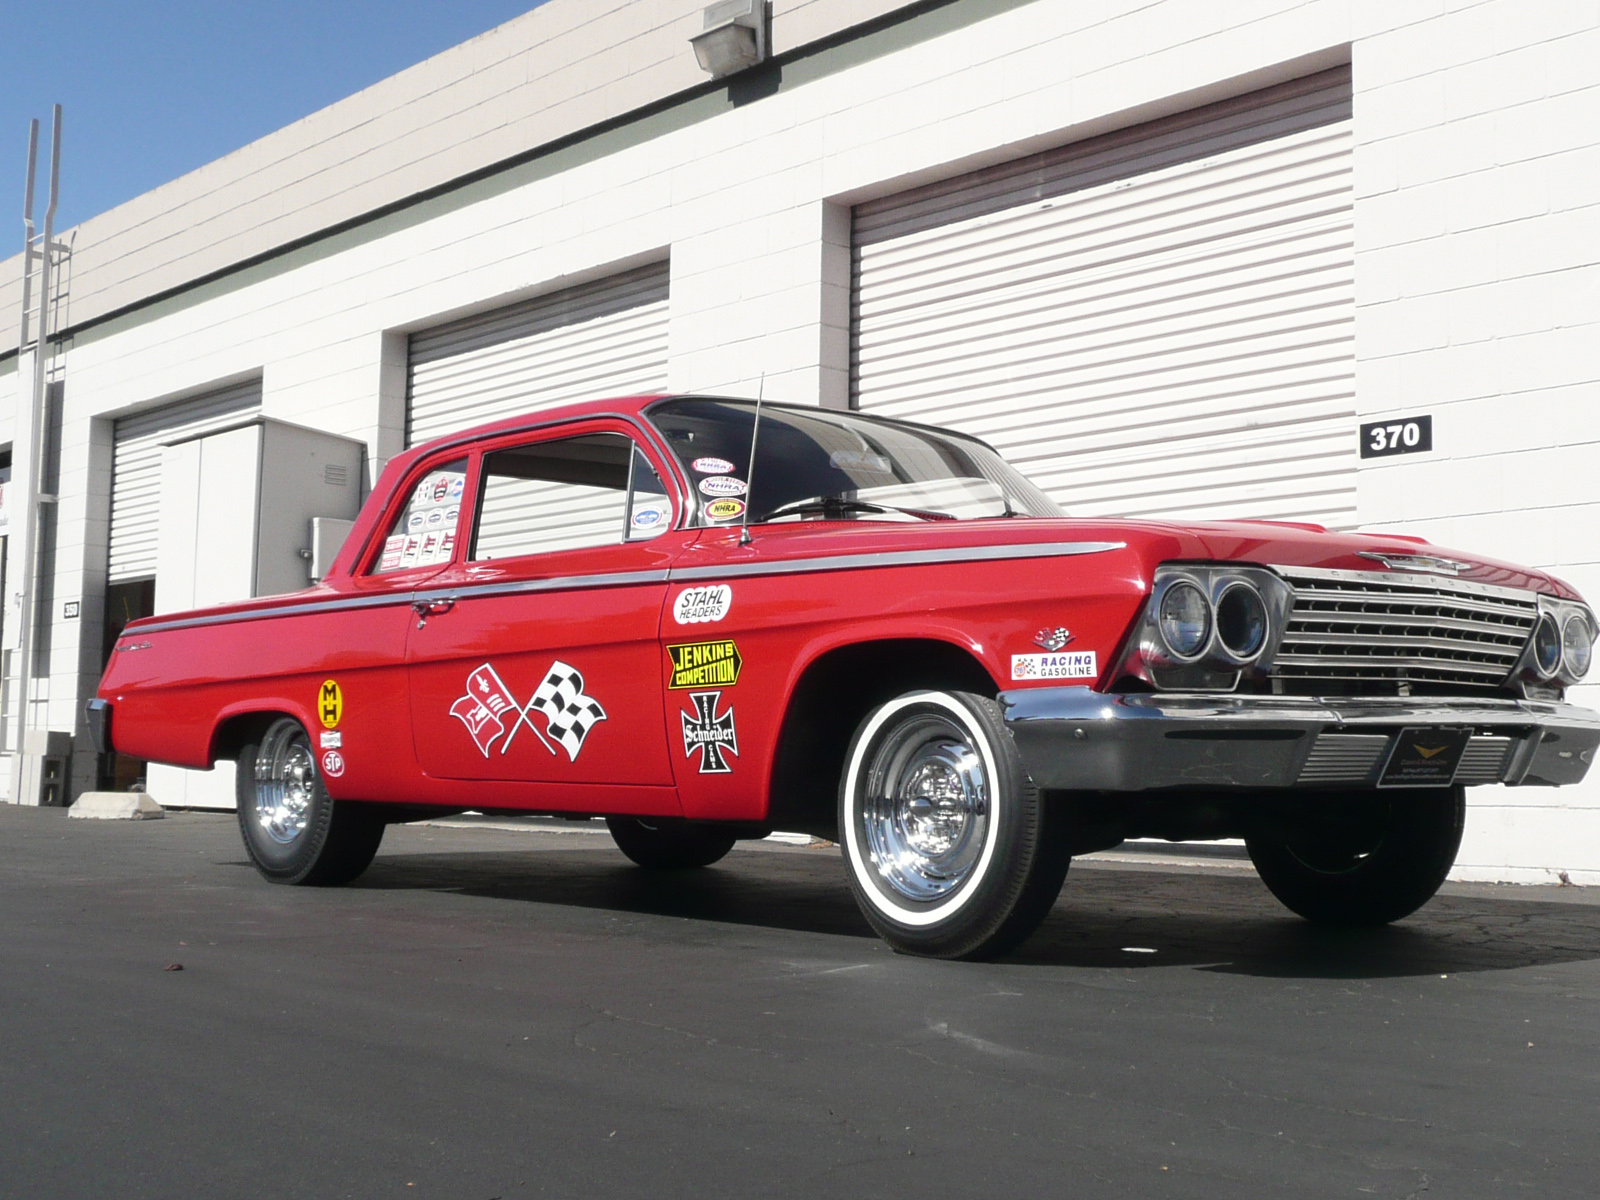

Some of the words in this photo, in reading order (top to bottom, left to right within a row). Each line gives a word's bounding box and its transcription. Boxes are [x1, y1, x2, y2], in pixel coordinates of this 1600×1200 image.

[1370, 423, 1419, 450] 370
[707, 482, 740, 492] NHRA
[714, 504, 736, 512] NHRA
[682, 590, 724, 608] STAHL
[680, 605, 722, 619] HEADERS
[676, 643, 734, 671] JENKINS
[1041, 656, 1092, 666] RACING
[676, 658, 735, 685] COMPETITION
[1041, 667, 1092, 677] GASOLINE
[686, 724, 733, 743] Schneider
[325, 754, 341, 771] STP
